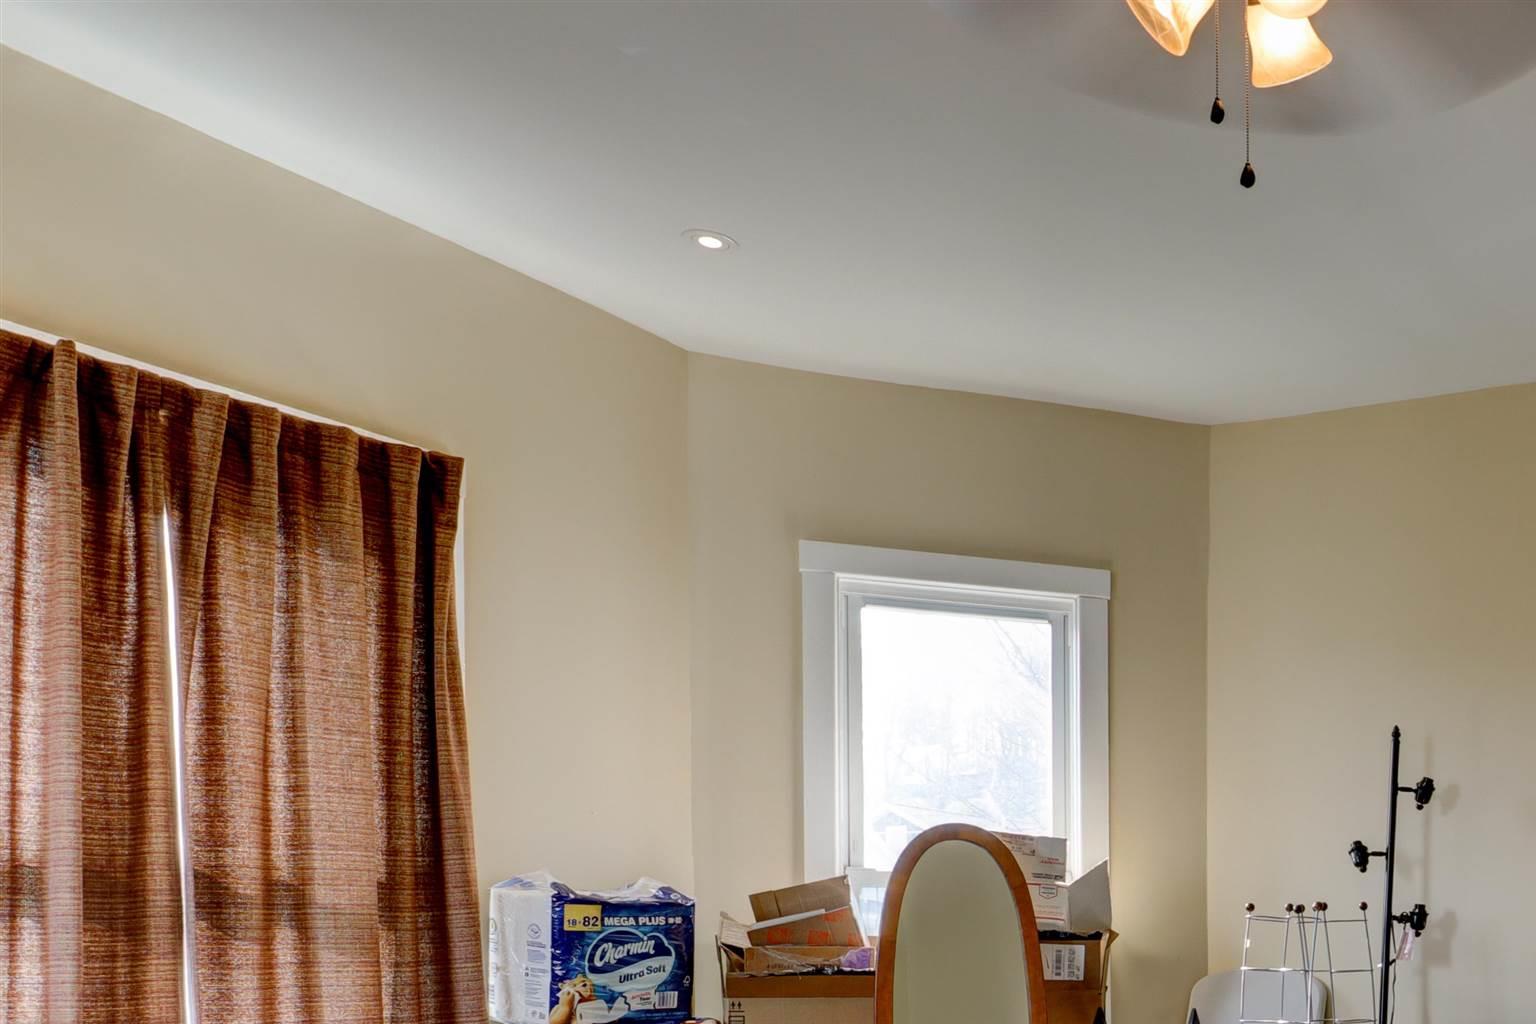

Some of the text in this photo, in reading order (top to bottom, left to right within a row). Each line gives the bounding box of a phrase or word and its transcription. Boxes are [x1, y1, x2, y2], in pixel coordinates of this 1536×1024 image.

[582, 916, 599, 927] 82
[604, 917, 636, 926] MEGA
[639, 916, 666, 925] PLUS
[593, 939, 655, 967] Charmin
[619, 964, 667, 984] Ultra Soft
